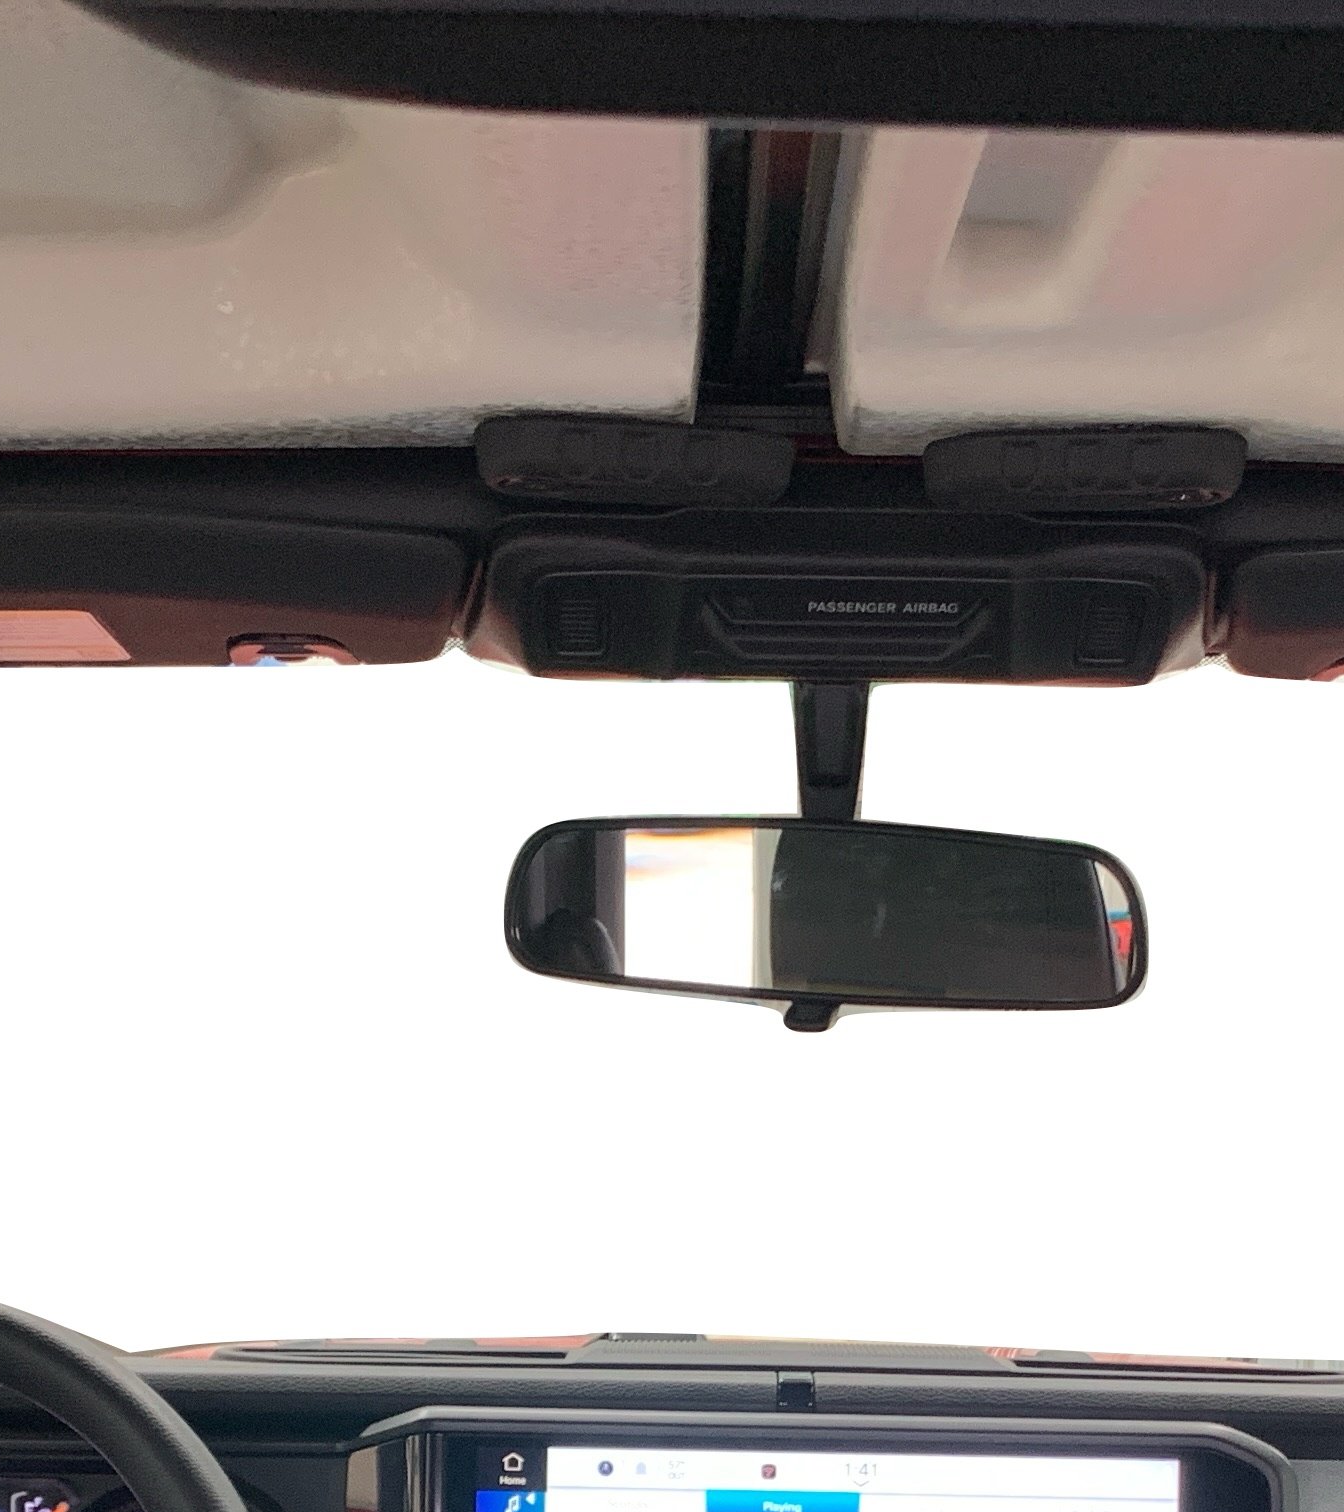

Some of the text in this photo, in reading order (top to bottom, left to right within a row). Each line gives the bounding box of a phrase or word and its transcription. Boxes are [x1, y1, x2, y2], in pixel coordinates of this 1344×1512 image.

[807, 601, 959, 614] PASSENGER AIRBAG
[499, 1475, 527, 1486] Home
